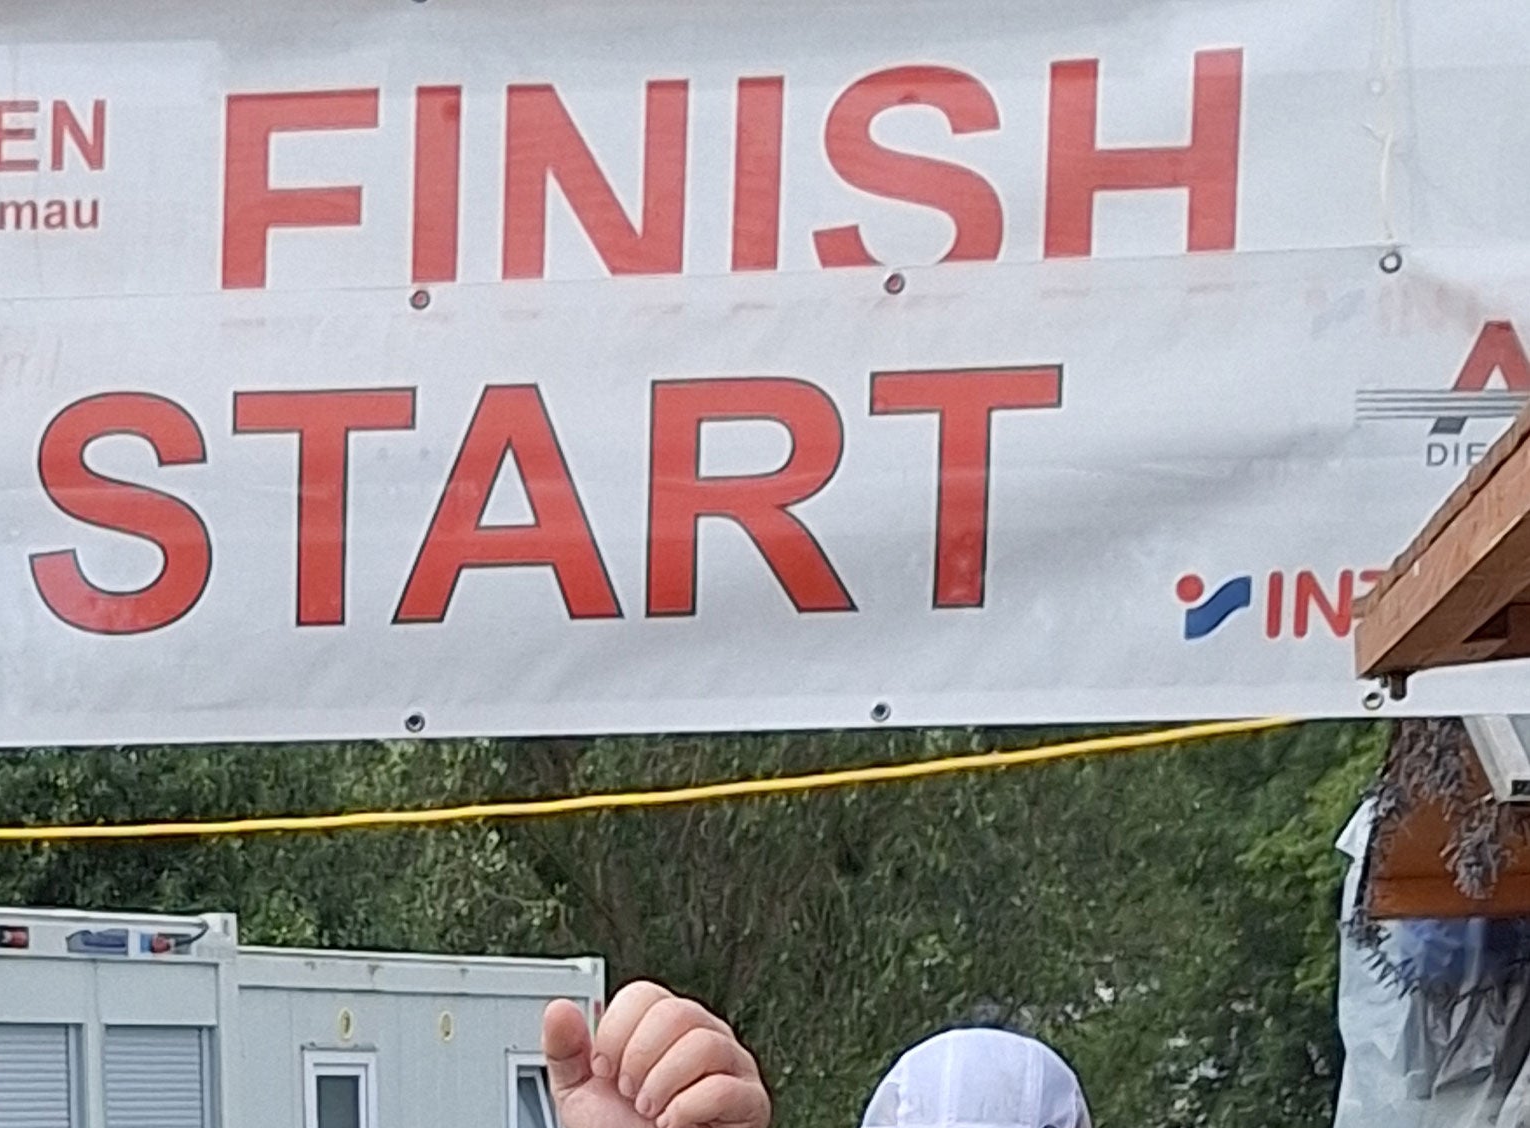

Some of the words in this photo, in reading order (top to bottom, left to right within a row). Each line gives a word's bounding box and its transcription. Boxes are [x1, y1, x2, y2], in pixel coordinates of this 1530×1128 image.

[221, 47, 1244, 290] FINISH
[29, 364, 1063, 635] START
[1265, 568, 1391, 639] IN
